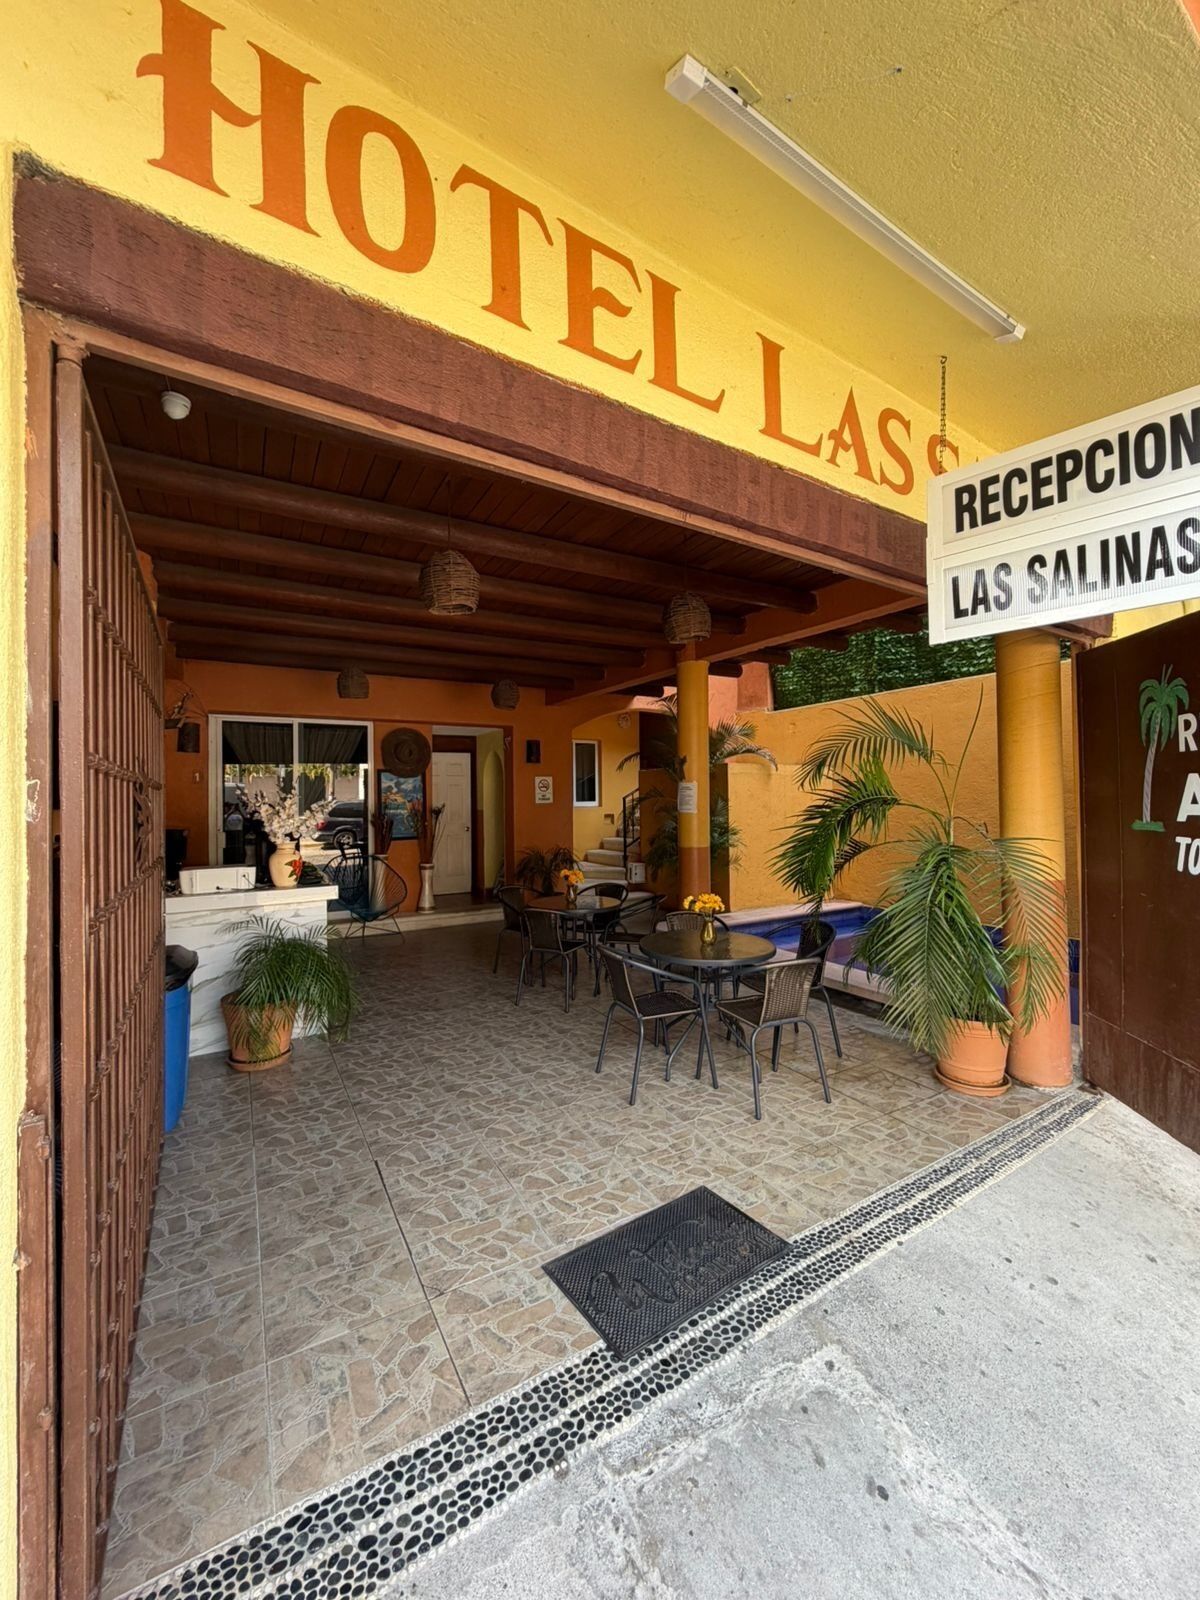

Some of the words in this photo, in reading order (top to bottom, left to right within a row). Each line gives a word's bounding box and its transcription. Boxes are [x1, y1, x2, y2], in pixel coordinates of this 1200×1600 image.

[136, 0, 726, 414] HOTEL
[756, 331, 915, 496] LAS
[954, 406, 1200, 534] RECEPCION
[951, 562, 1013, 619] LAS
[1026, 516, 1200, 605] SALINAS
